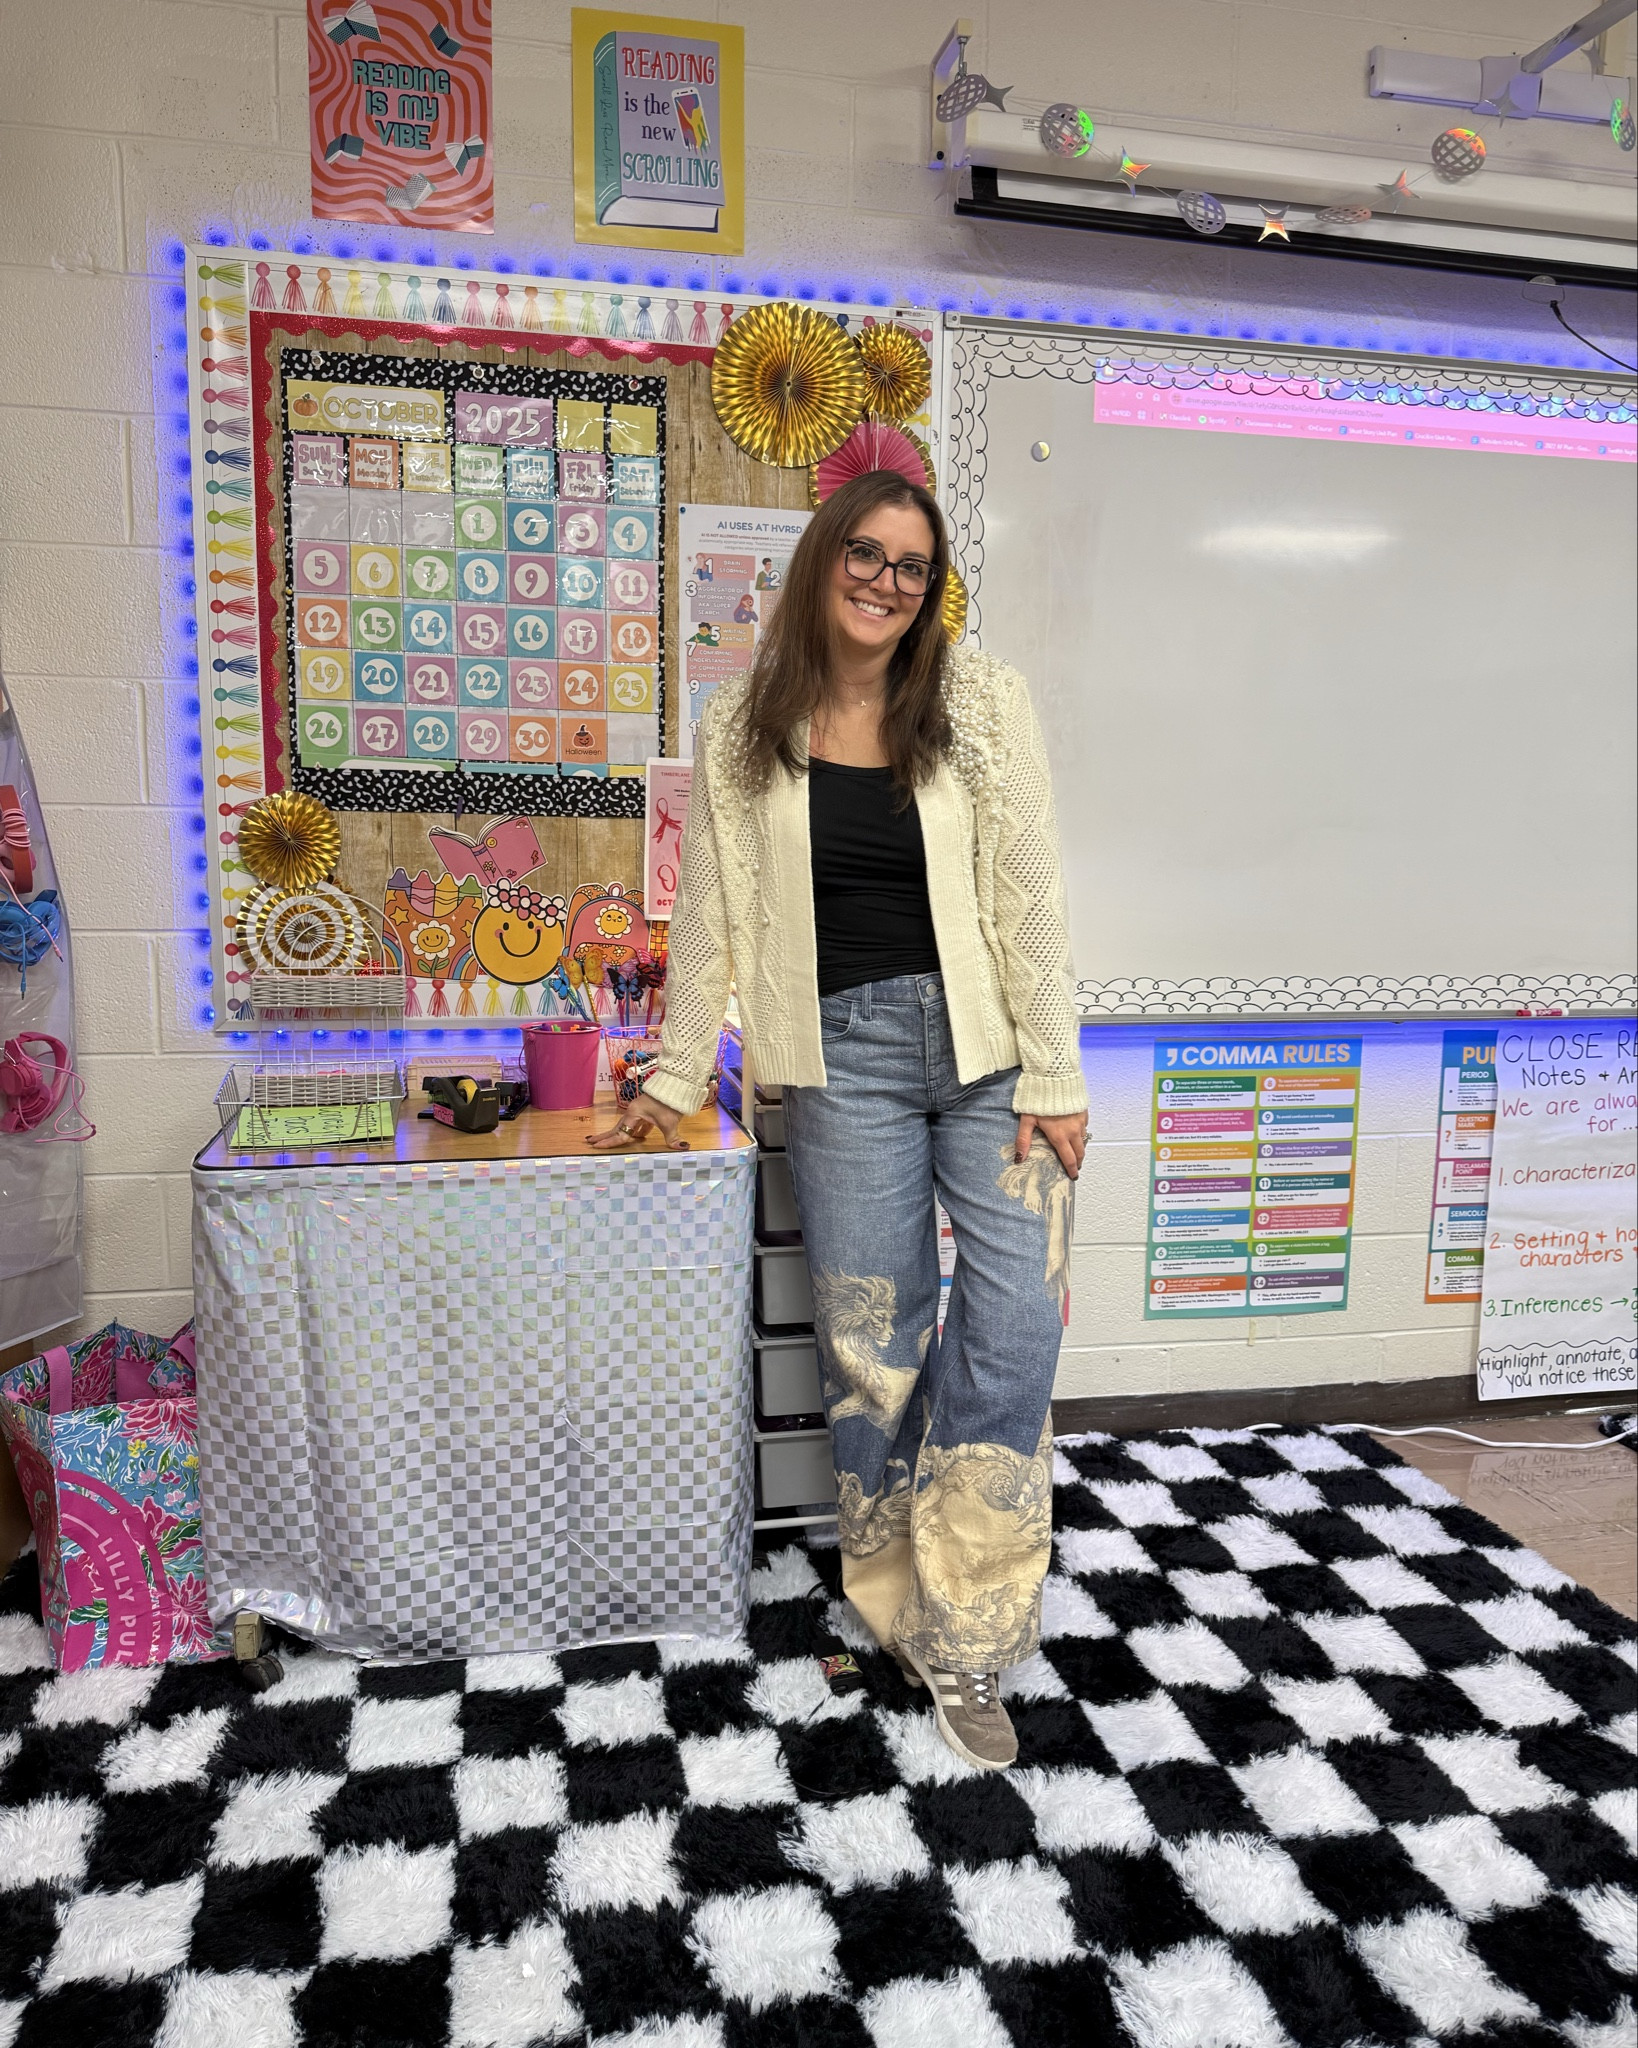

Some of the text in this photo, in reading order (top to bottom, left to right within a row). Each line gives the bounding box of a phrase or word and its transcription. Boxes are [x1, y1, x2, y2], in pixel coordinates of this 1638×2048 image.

[352, 59, 451, 95] READING
[622, 47, 716, 86] READING
[365, 91, 389, 117] IS
[624, 91, 670, 116] is the
[375, 119, 432, 151] VIBE
[641, 122, 677, 142] new
[622, 151, 720, 190] SCROLLING
[323, 396, 543, 436] OCTOBER 2025
[300, 444, 337, 464] SUN.
[356, 448, 391, 466] MON.
[462, 454, 497, 471] WED.
[513, 457, 548, 475] THU.
[566, 461, 597, 481] FRI.
[619, 465, 654, 484] SAT.
[357, 468, 390, 480] Monday
[569, 483, 596, 496] Friday
[620, 487, 656, 496] Saturday
[471, 512, 637, 545] 1 2 3 4
[717, 521, 803, 534] AI USES AT HVRSD
[314, 555, 644, 597] 5 6 7 8 9 10 11
[705, 558, 713, 574] 1
[770, 569, 781, 587] 2
[685, 580, 698, 597] 3
[309, 610, 646, 651] 12 13 14 15 16 17 18
[710, 625, 721, 641] 5
[685, 641, 697, 656] 7
[313, 661, 644, 698] 19 20 21 22 23 24 25
[689, 679, 700, 695] 9
[309, 719, 603, 757] 26 27 28 29 30 Halloween
[1182, 1043, 1350, 1066] COMMA RULES
[1503, 1033, 1603, 1063] CLOSE
[1461, 1071, 1489, 1079] PERIOD
[1522, 1064, 1586, 1088] Notes
[1265, 1113, 1271, 1121] 9
[1502, 1098, 1533, 1117] We
[1546, 1099, 1580, 1116] are
[1164, 1119, 1170, 1127] 2
[1498, 1167, 1508, 1187] 1.
[1489, 1232, 1506, 1250] 2.
[1514, 1229, 1590, 1255] Setting
[1520, 1248, 1624, 1267] characters
[1500, 1297, 1603, 1316] Inferences
[1480, 1351, 1553, 1378] Highlight,
[1556, 1346, 1626, 1365] annotate,
[1505, 1366, 1636, 1393] you notice these
[98, 1536, 136, 1602] LILLY
